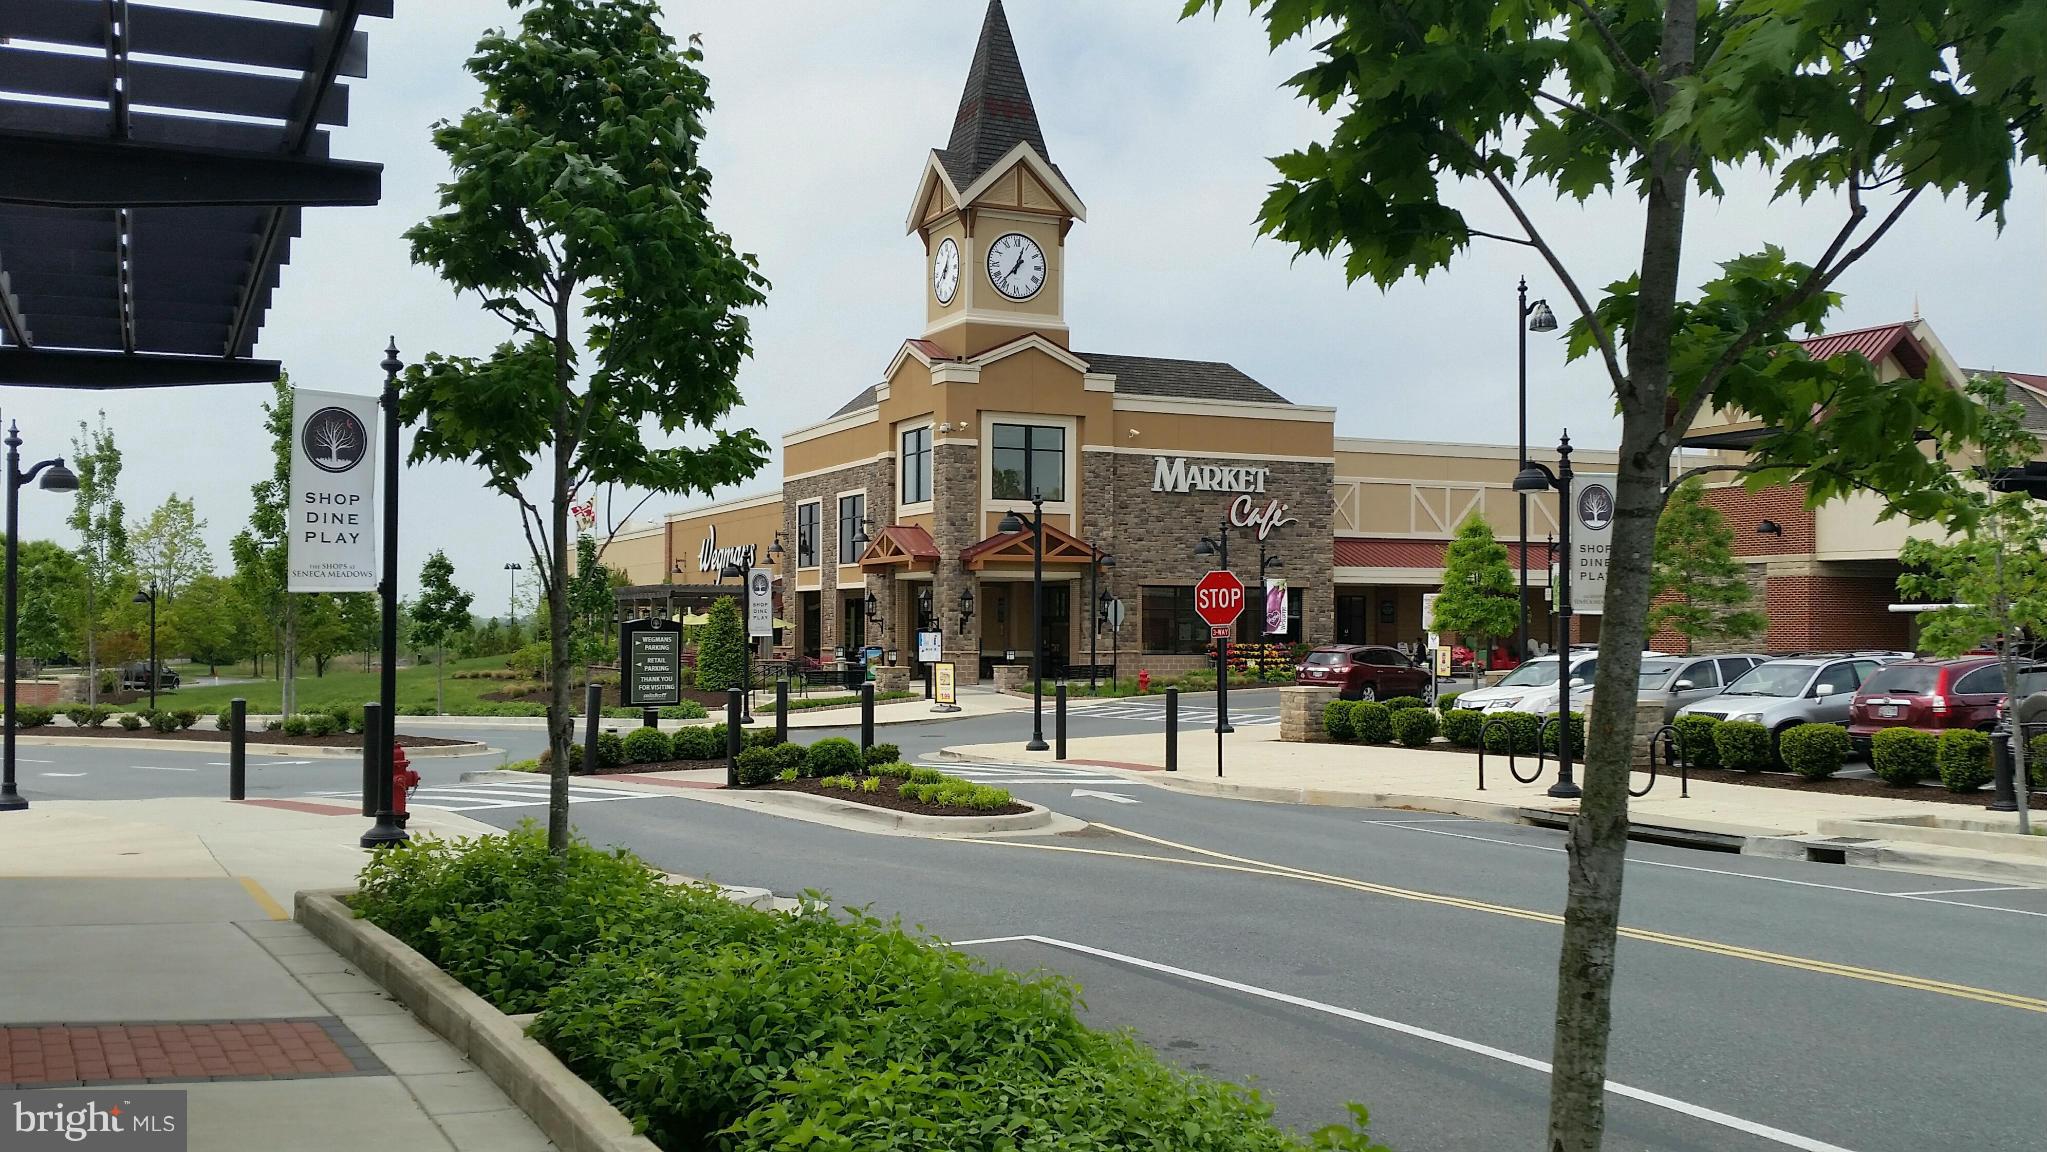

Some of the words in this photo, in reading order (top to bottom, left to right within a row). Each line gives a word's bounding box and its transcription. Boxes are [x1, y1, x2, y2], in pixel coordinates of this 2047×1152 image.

[305, 492, 360, 505] SHOP
[306, 512, 359, 524] DINE
[1230, 494, 1299, 541] Café
[305, 532, 359, 543] PLAY
[292, 570, 326, 578] SENECA
[1581, 572, 1608, 580] PLA
[1200, 588, 1240, 608] STOP
